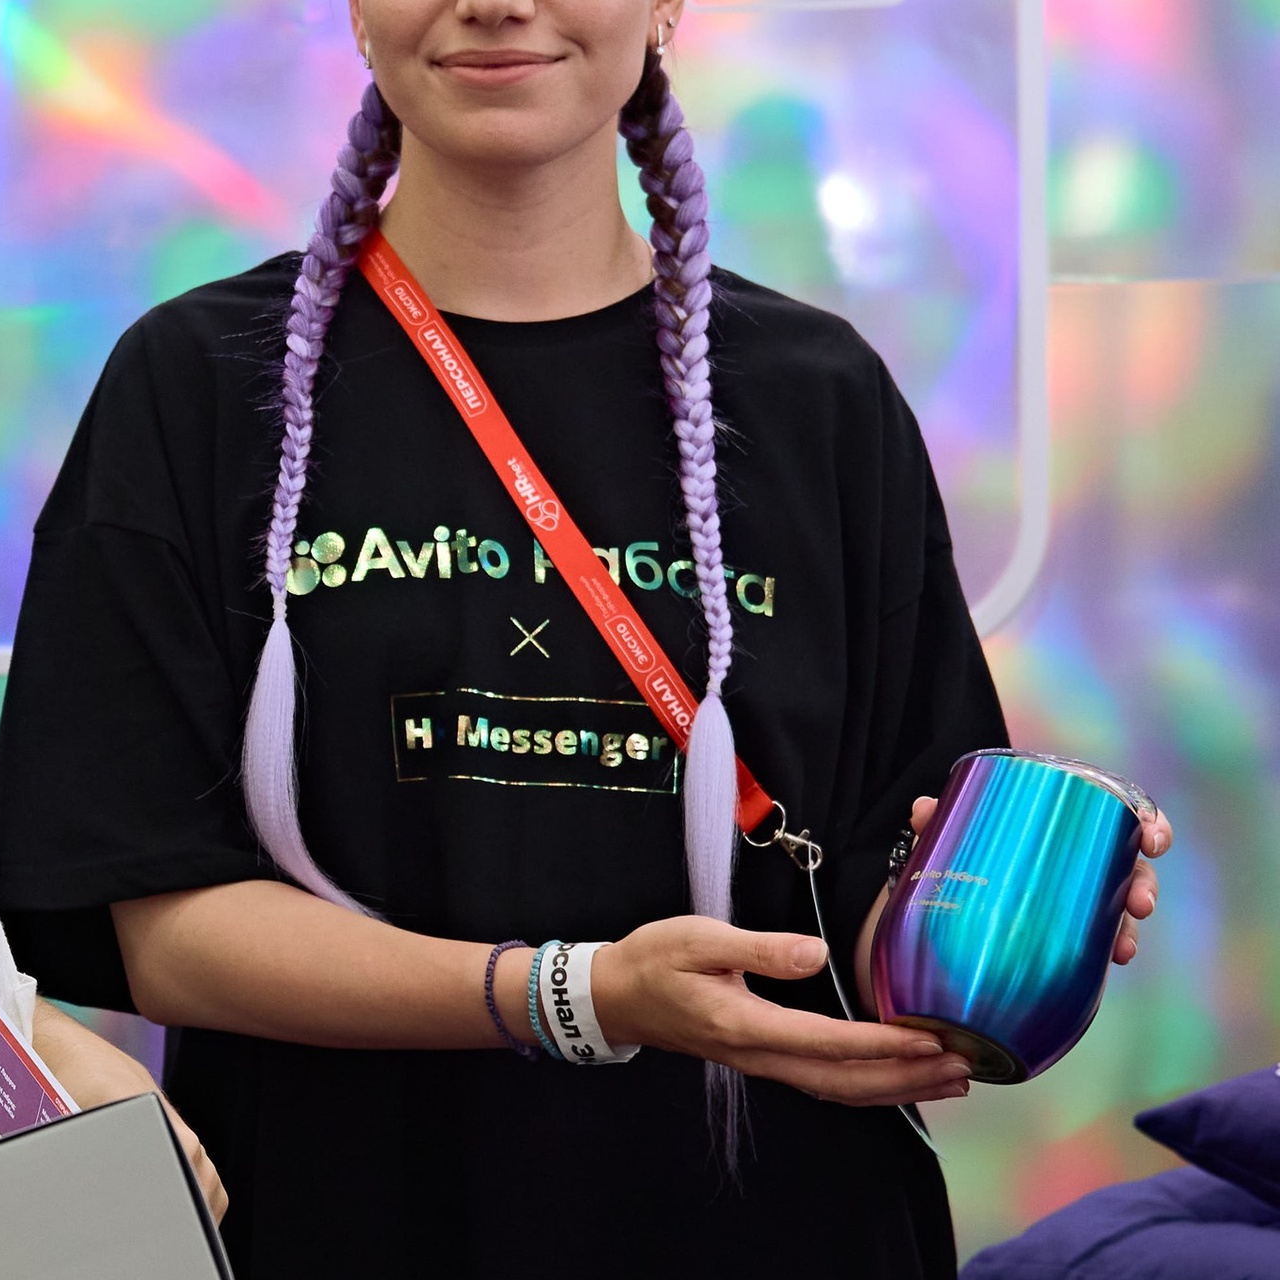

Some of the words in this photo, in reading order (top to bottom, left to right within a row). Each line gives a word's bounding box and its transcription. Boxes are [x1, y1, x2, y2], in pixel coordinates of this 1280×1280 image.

[394, 287, 422, 319] ЭКСПО
[423, 329, 482, 409] ПЕРСОНАЛ
[507, 458, 540, 505] HRnet
[351, 525, 510, 581] Avito
[616, 623, 648, 665] ЭКСПО
[457, 714, 668, 767] Messenger
